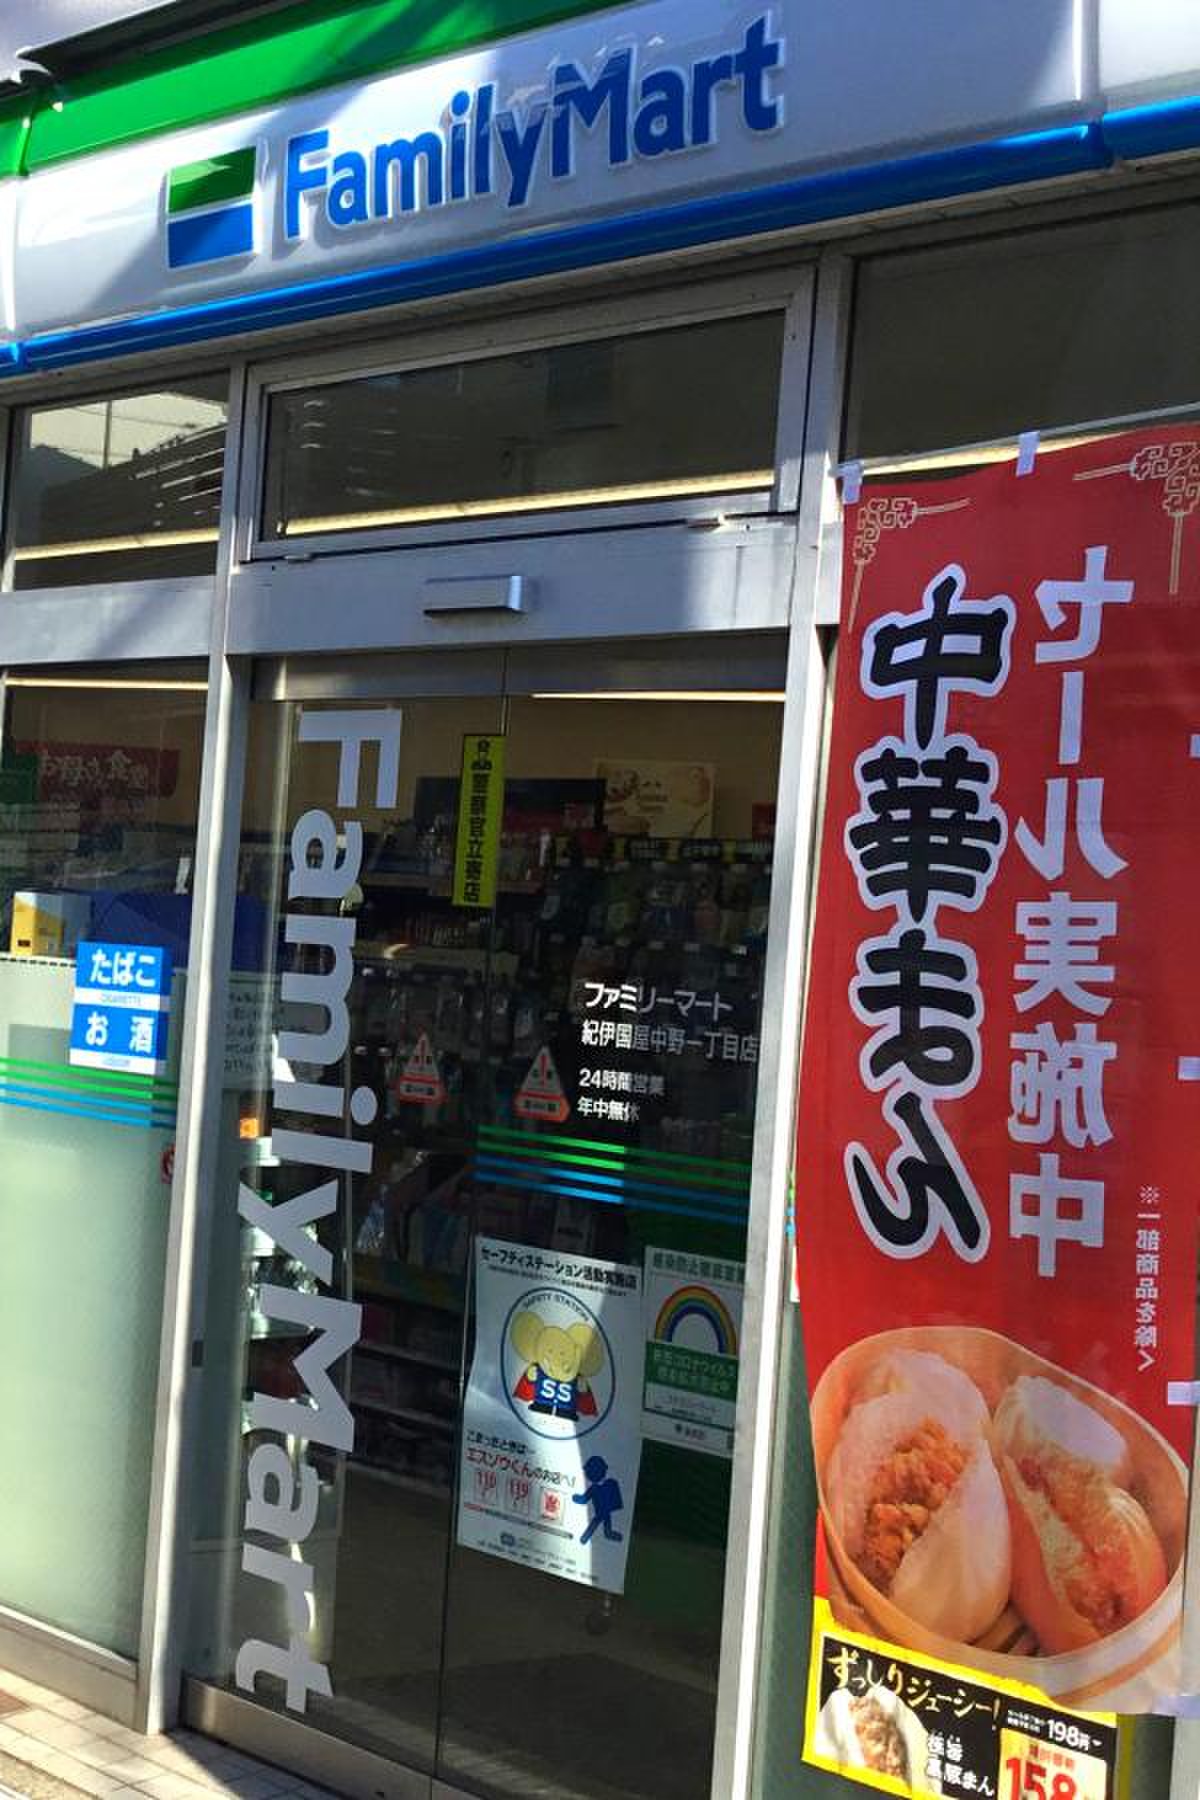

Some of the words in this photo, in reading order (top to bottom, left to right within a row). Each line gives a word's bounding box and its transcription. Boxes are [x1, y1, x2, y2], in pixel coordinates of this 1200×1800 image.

[285, 14, 782, 239] FamilyMart
[89, 947, 157, 988] たばこ
[584, 981, 733, 1022] ファミリーマート
[581, 1019, 759, 1062] 紀伊国屋中野一丁目店
[578, 1068, 665, 1096] 24時間営業
[577, 1096, 640, 1122] 年中無休
[236, 706, 403, 1714] FamilyMart
[540, 1377, 573, 1403] SS
